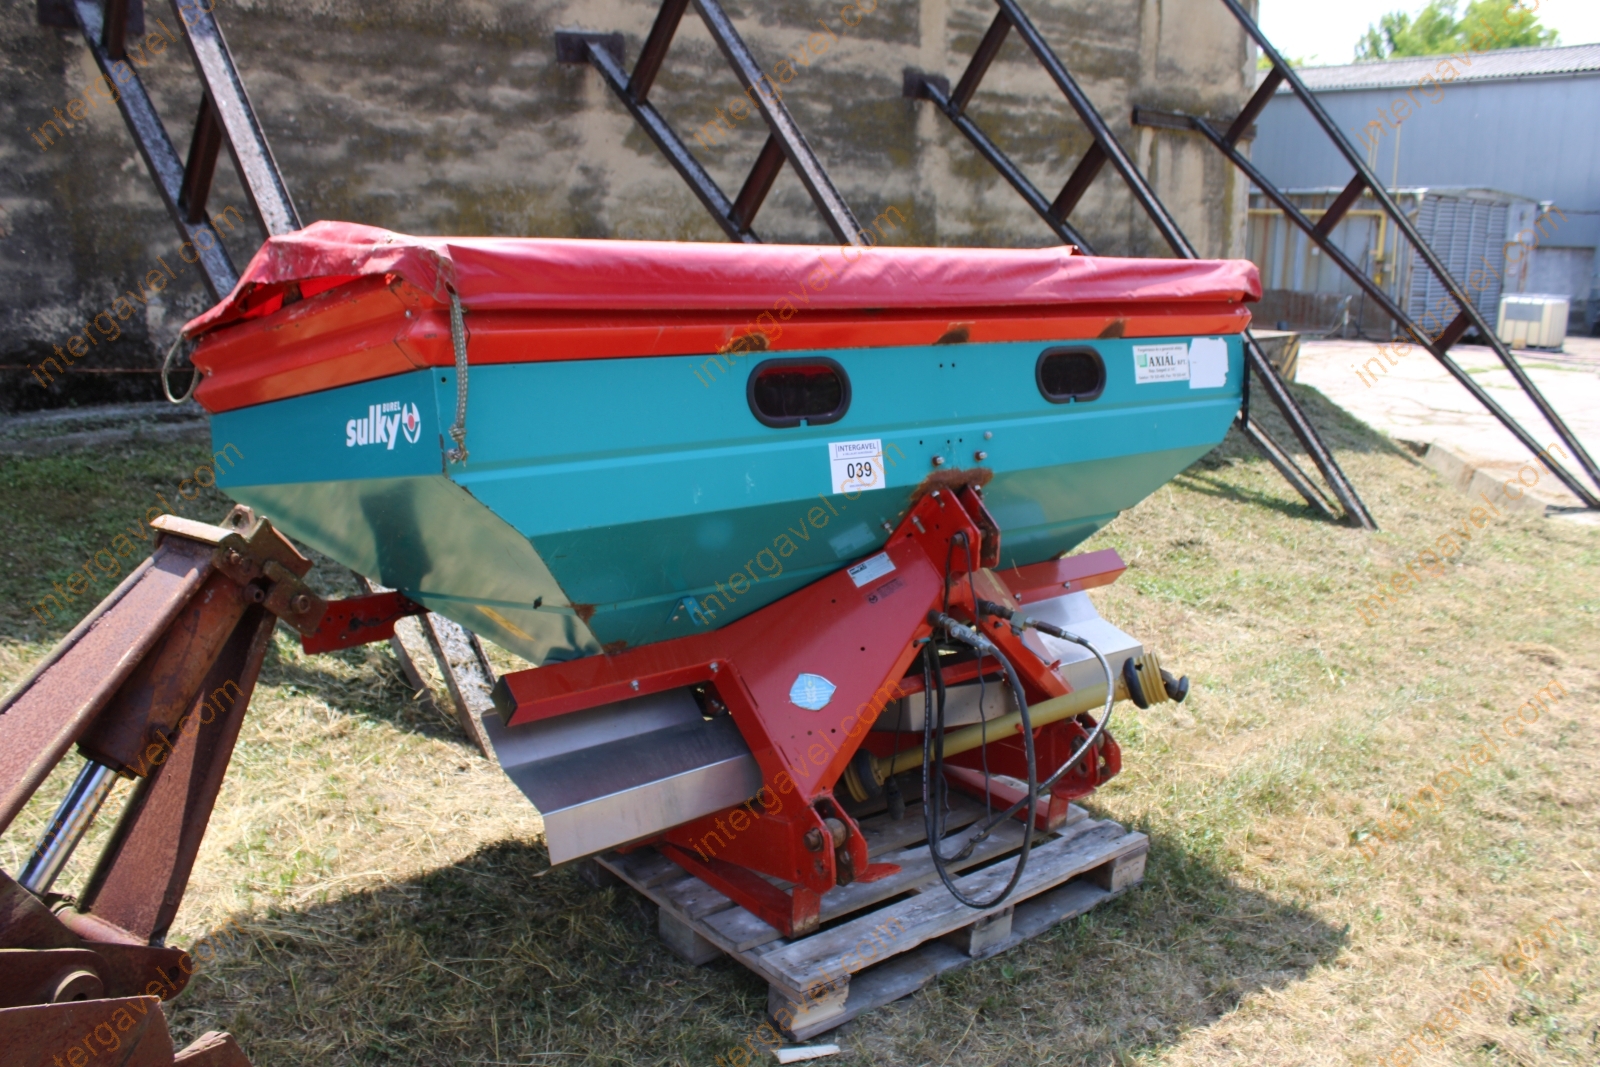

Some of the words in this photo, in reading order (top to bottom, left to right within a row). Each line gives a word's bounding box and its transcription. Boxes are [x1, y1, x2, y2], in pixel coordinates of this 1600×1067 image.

[1149, 352, 1176, 367] AXIÁL
[382, 401, 401, 413] BUREL
[346, 404, 401, 450] sulky
[837, 443, 876, 452] INTERGAVEL
[847, 461, 872, 478] 039
